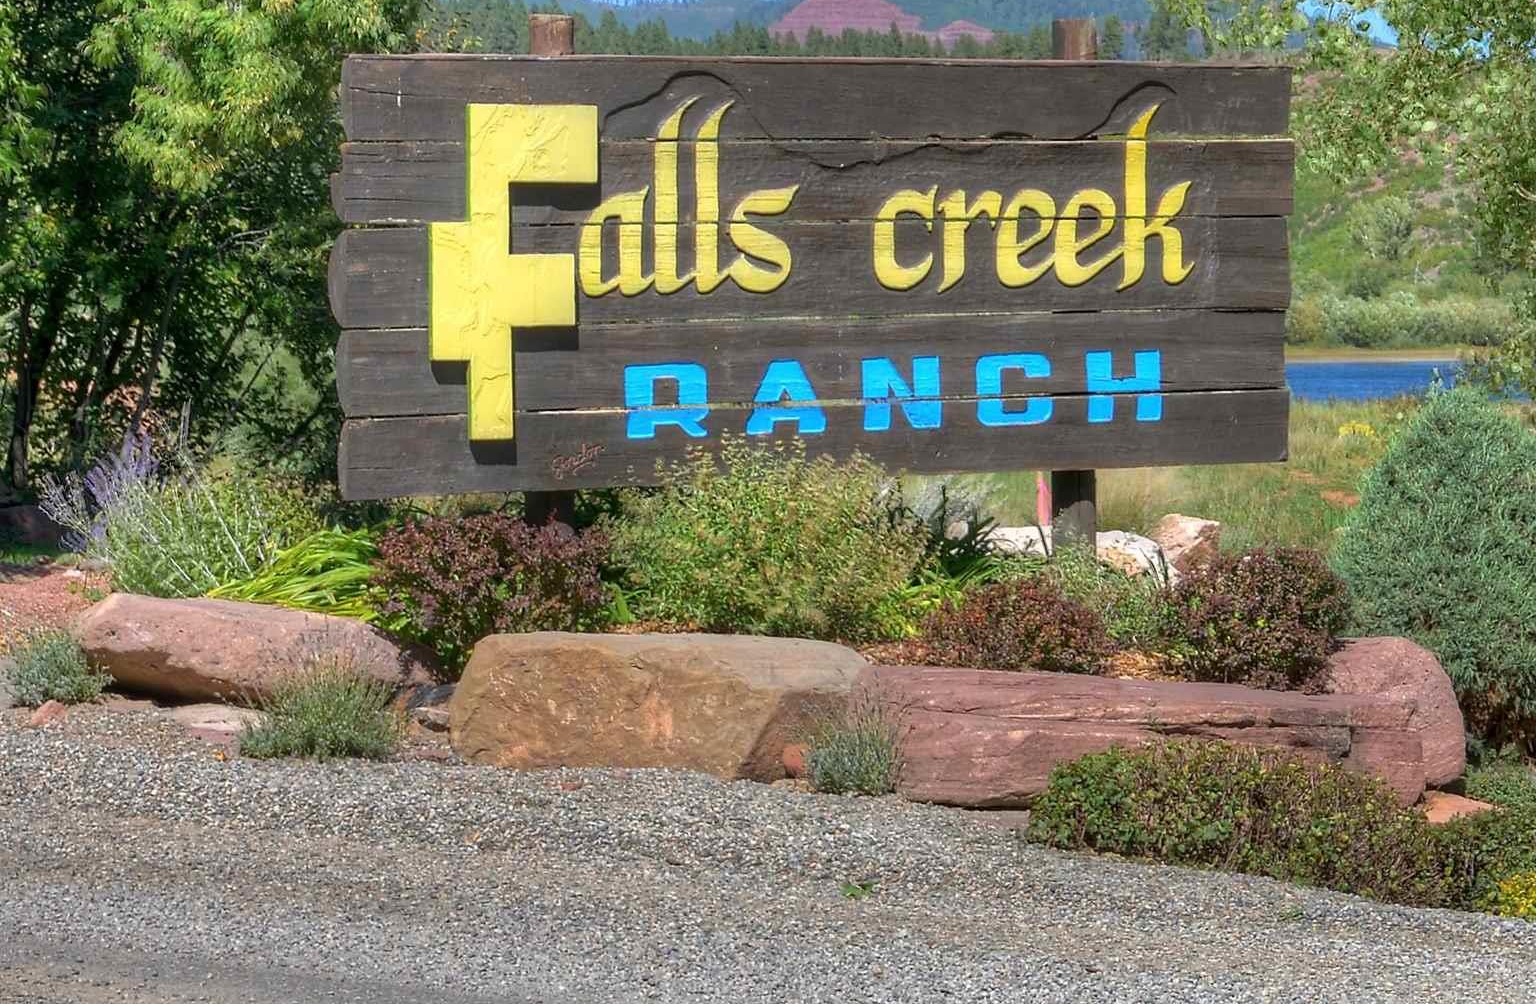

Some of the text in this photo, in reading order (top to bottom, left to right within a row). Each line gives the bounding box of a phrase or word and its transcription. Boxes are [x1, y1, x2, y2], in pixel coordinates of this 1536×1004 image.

[429, 95, 1195, 441] Falls creek
[623, 349, 1163, 439] RANCH
